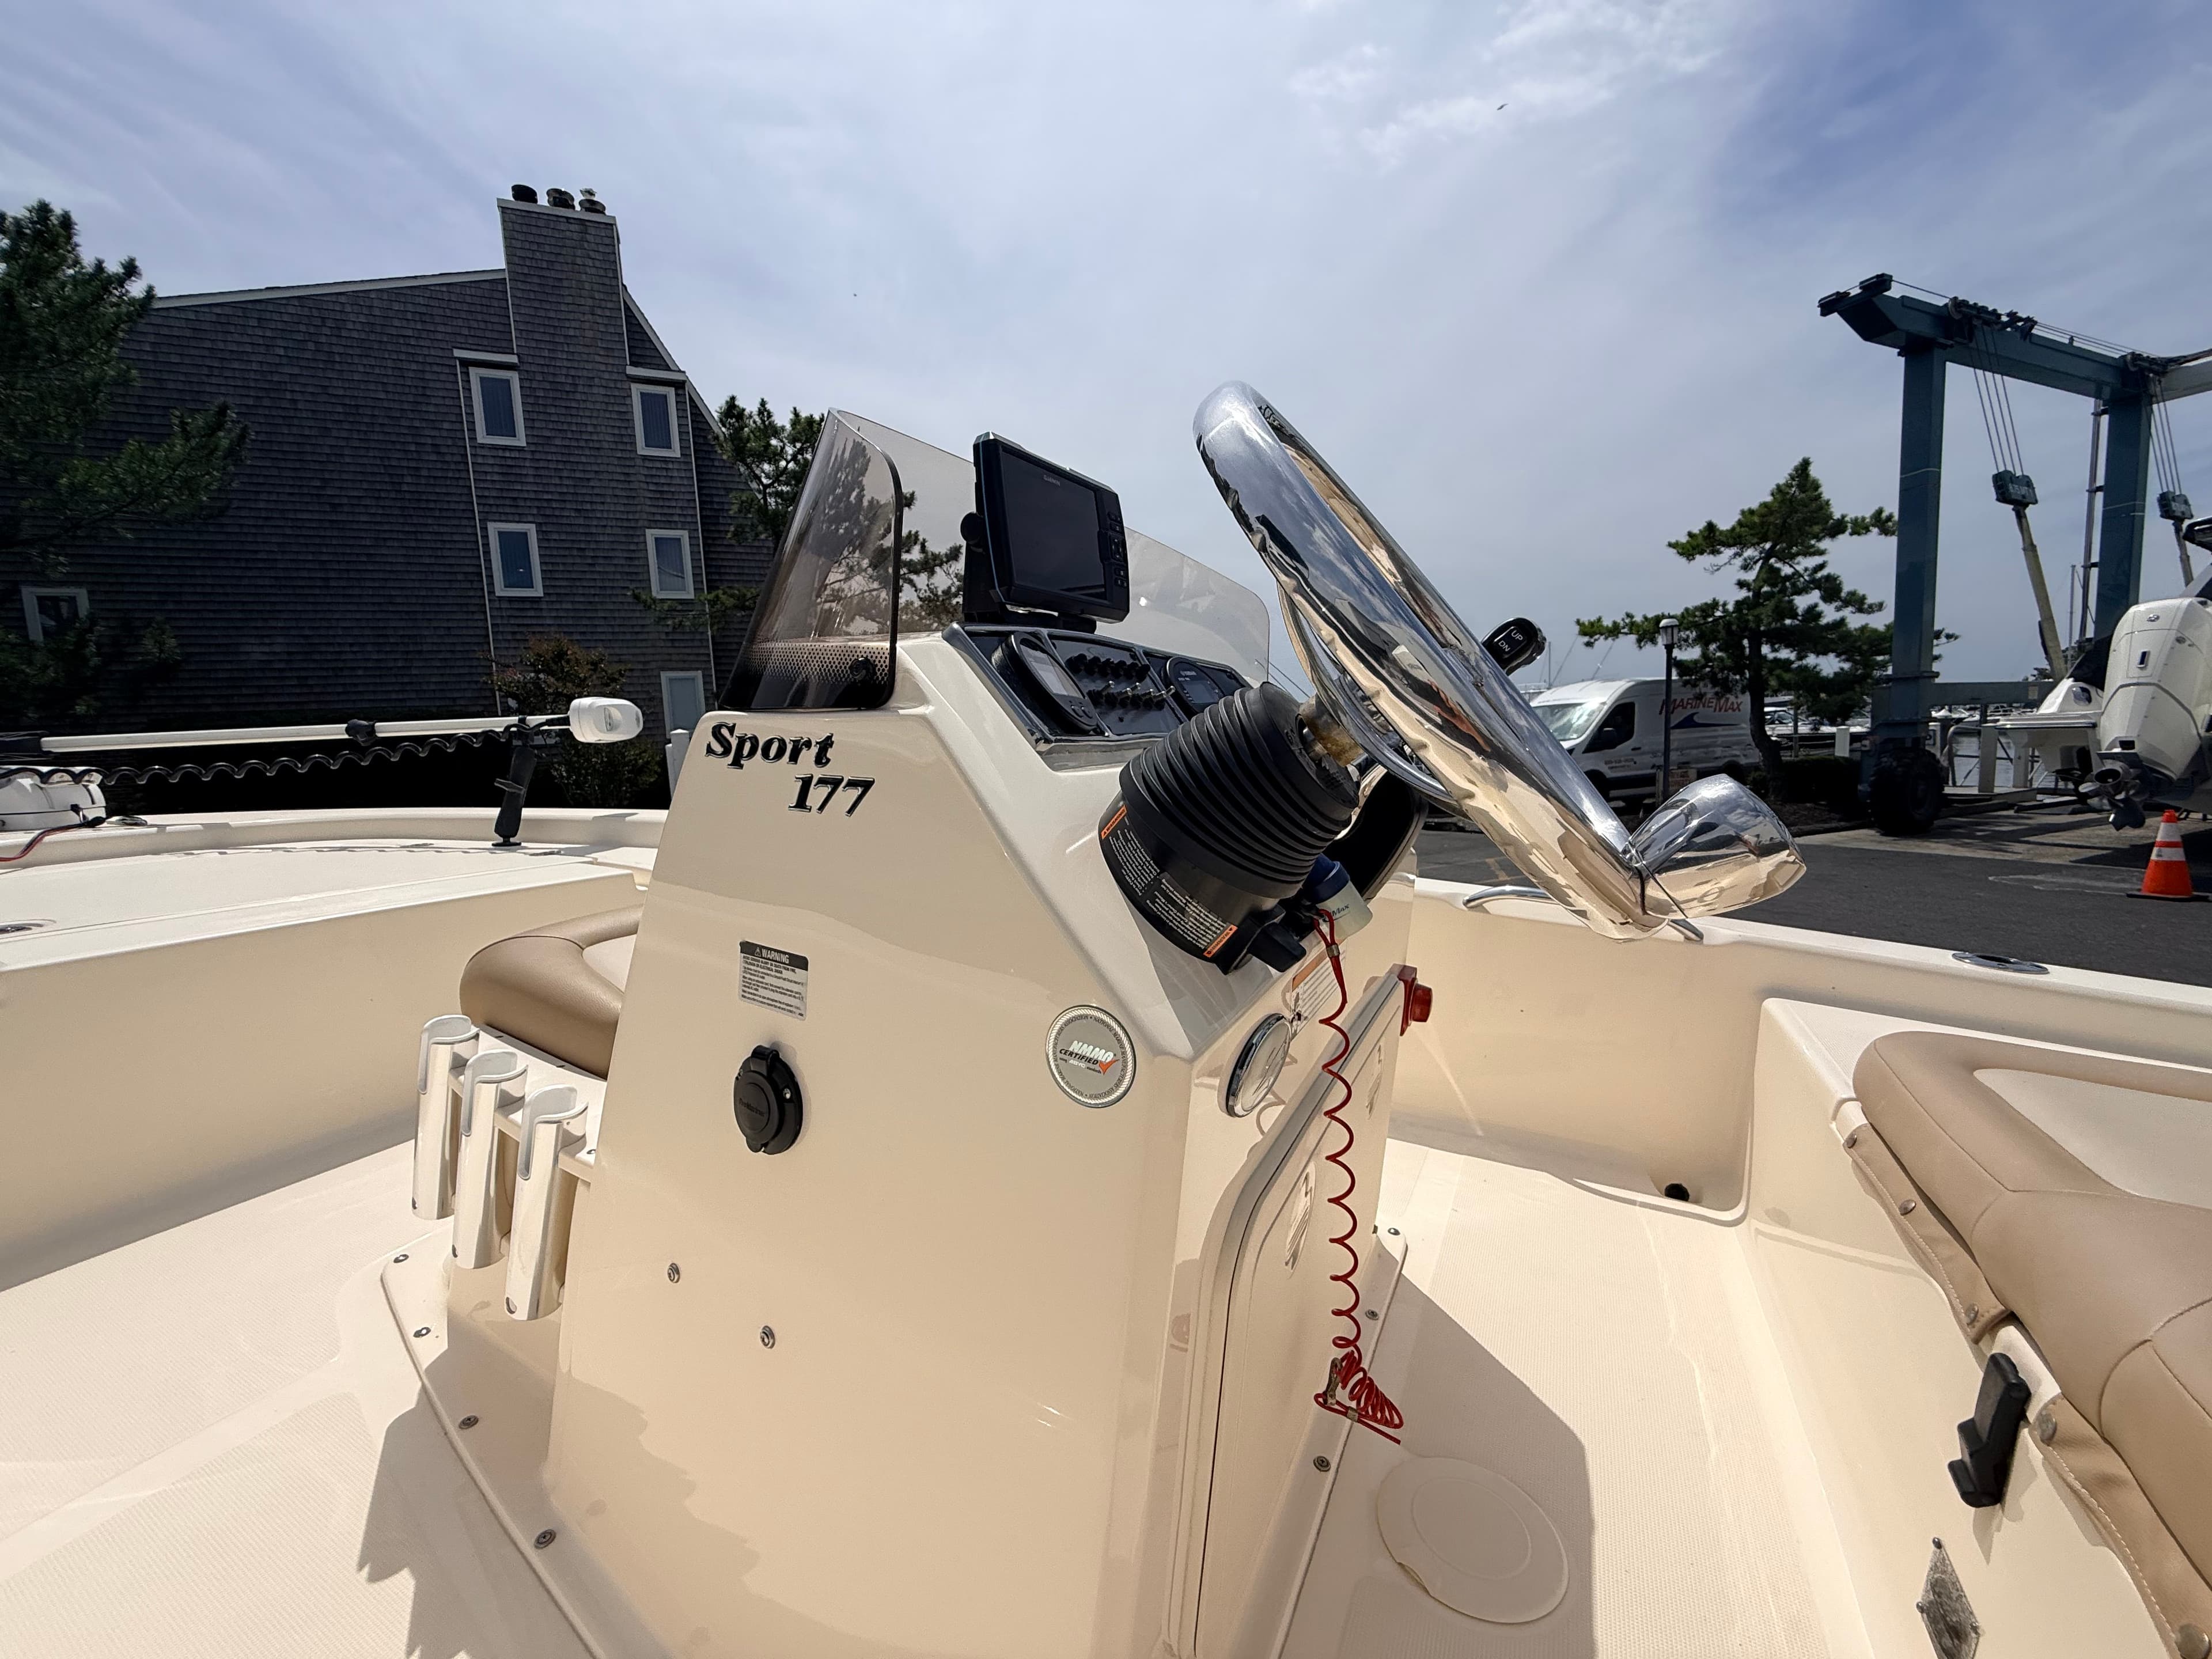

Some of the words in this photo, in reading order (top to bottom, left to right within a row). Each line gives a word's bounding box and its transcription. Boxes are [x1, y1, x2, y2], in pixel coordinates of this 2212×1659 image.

[1511, 630, 1524, 641] UP
[1498, 640, 1511, 652] DN
[704, 721, 834, 769] Sport
[787, 773, 875, 817] 177
[762, 948, 789, 964] WARNING
[1059, 1048, 1099, 1065] CERTIFIED
